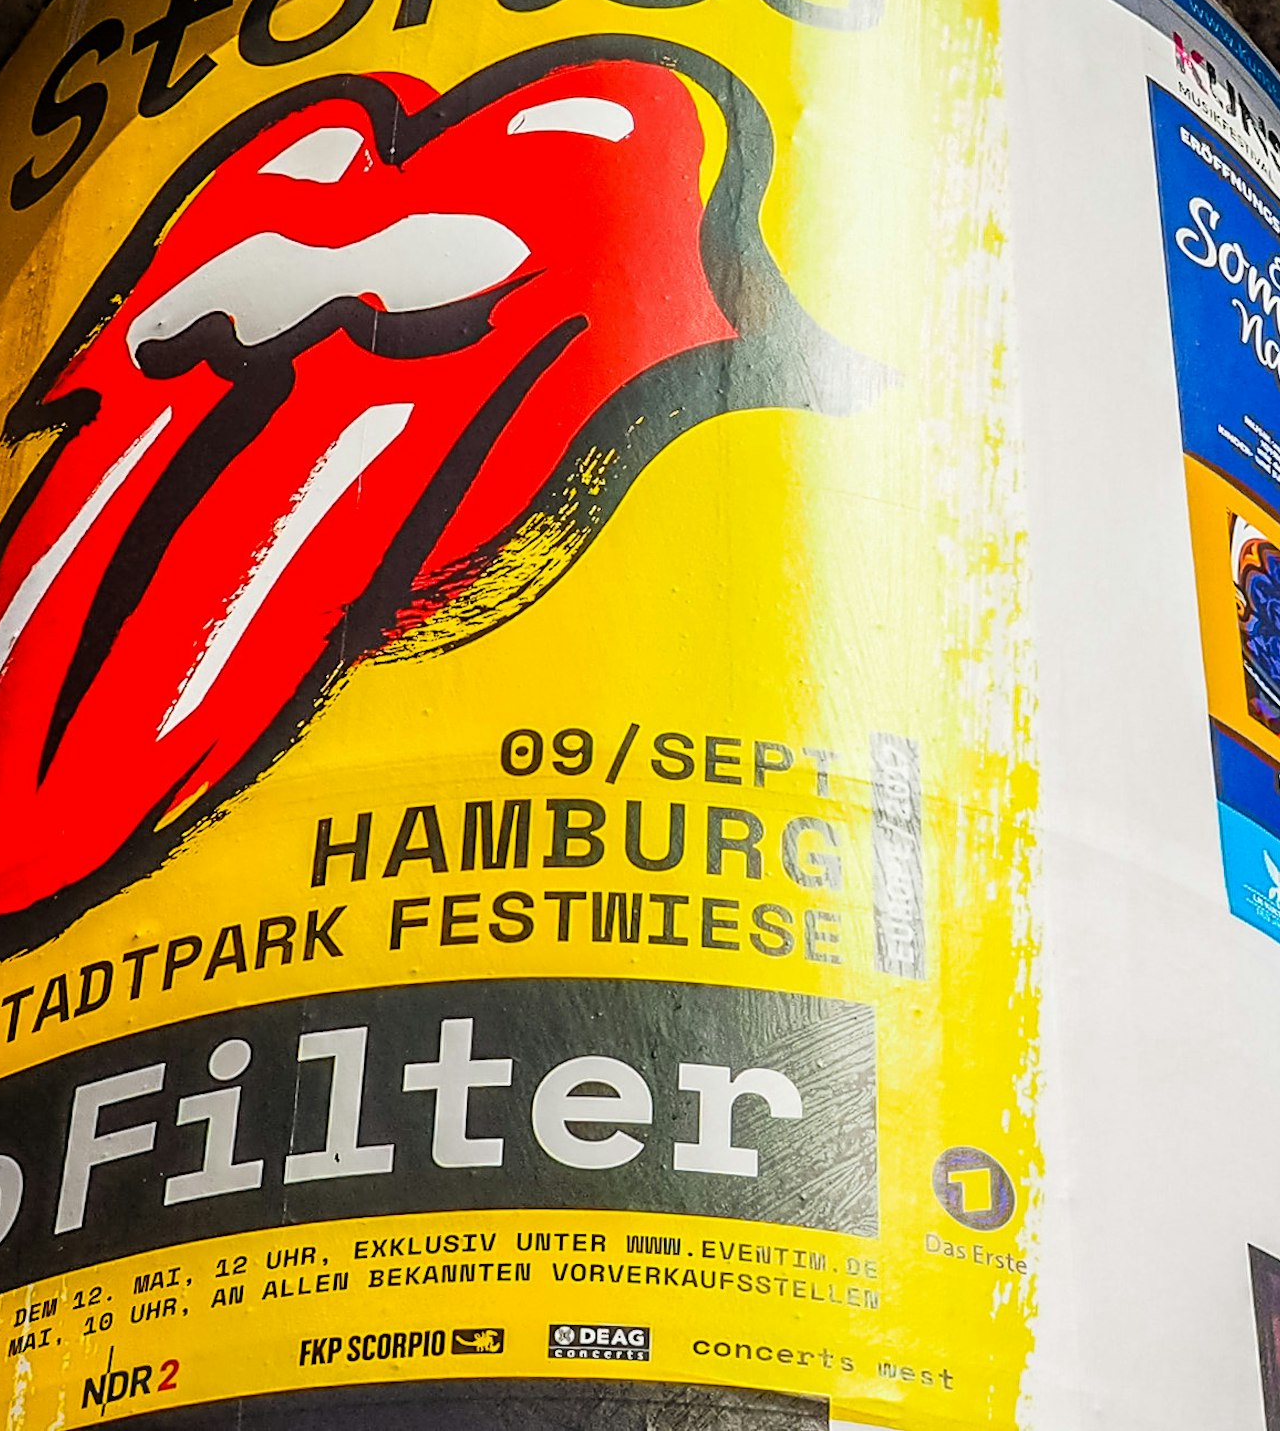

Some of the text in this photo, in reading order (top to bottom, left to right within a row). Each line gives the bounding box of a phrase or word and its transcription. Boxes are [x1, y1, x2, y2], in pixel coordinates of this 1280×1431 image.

[500, 722, 839, 797] 09/SEPT
[310, 798, 843, 892] HAMBURG
[389, 890, 843, 965] FESTWIESE
[13, 1298, 58, 1328] DEM
[72, 1286, 113, 1310] 12.
[133, 1267, 193, 1295] MAI,
[215, 1255, 248, 1278] 12
[266, 1247, 329, 1270] UHR,
[354, 1232, 497, 1259] EXKLUSIV
[516, 1232, 606, 1253] UNTER
[626, 1234, 879, 1279] WWW.EVENTIM.DE
[925, 1233, 1028, 1275] Das Erste
[7, 1328, 62, 1358] MAI,
[82, 1312, 114, 1336] 10
[130, 1297, 190, 1324] UHR,
[210, 1285, 245, 1309] AN
[261, 1272, 349, 1300] ALLEN
[368, 1262, 532, 1288] BEKANNTEN
[552, 1262, 880, 1310] VORVERKAUFSSTELLEN
[579, 1327, 645, 1346] DEAG
[299, 1330, 446, 1366] FKP SCORPIO
[554, 1349, 645, 1360] concerts
[692, 1339, 955, 1391] concerts west
